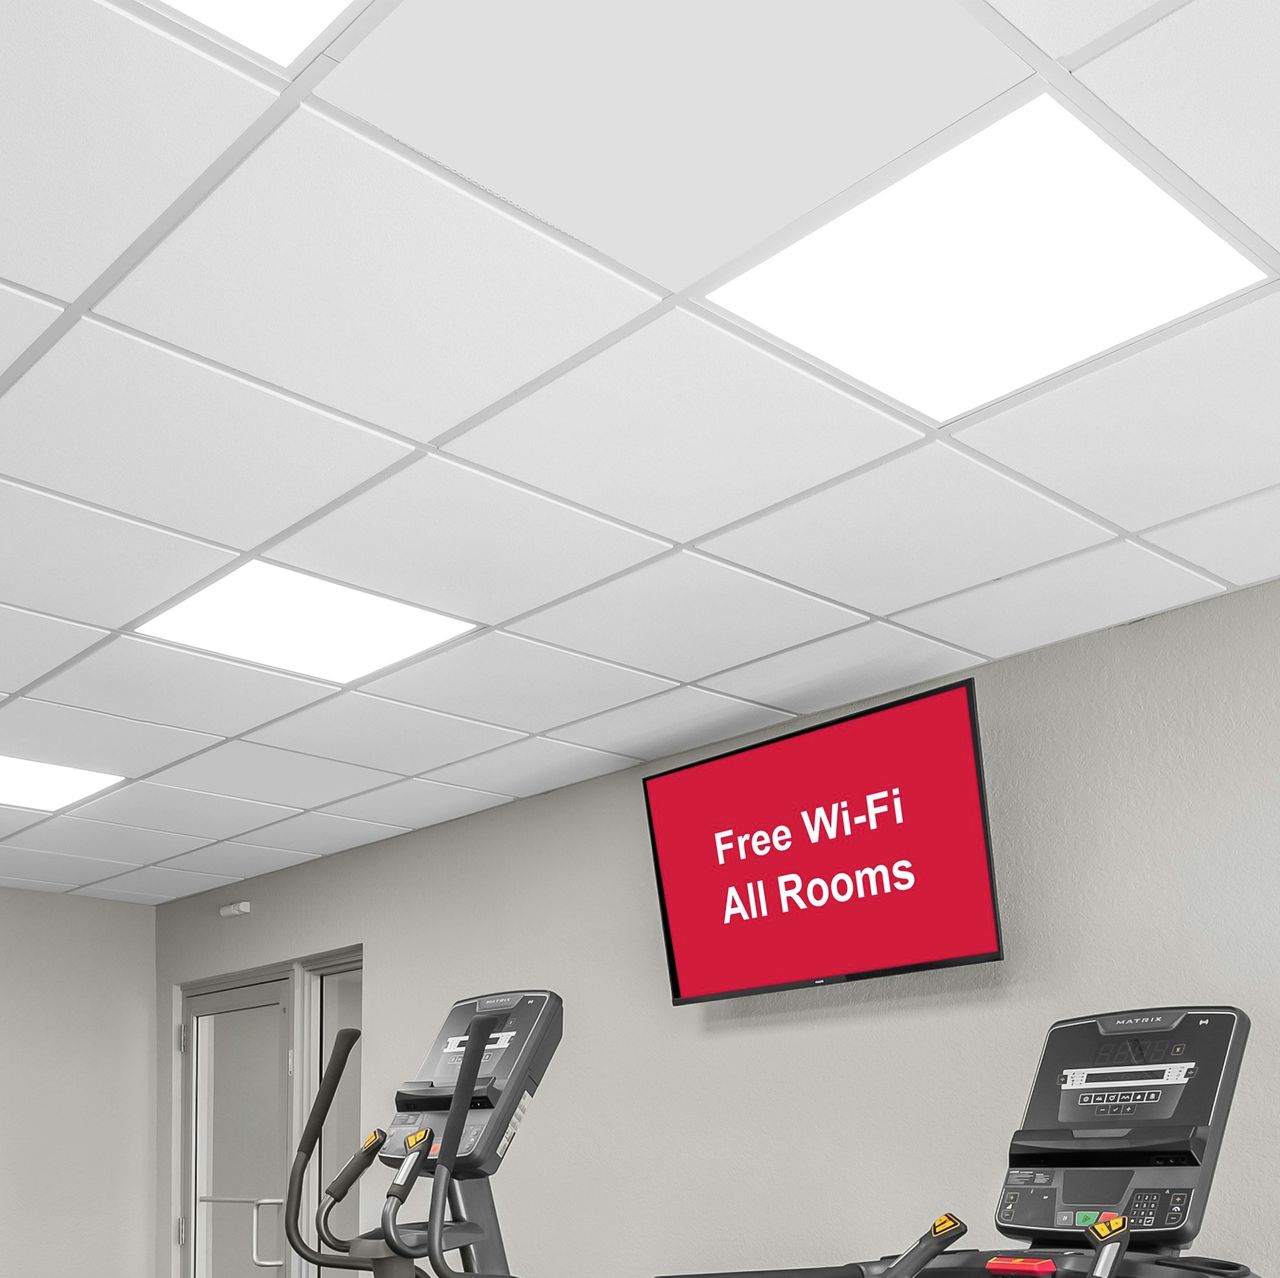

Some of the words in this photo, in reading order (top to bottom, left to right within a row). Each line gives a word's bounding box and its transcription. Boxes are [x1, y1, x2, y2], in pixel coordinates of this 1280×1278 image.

[714, 824, 793, 865] Free
[800, 787, 904, 844] Wi-Fi
[723, 879, 768, 925] All
[777, 859, 916, 913] Rooms
[1115, 1016, 1163, 1025] MATRIX
